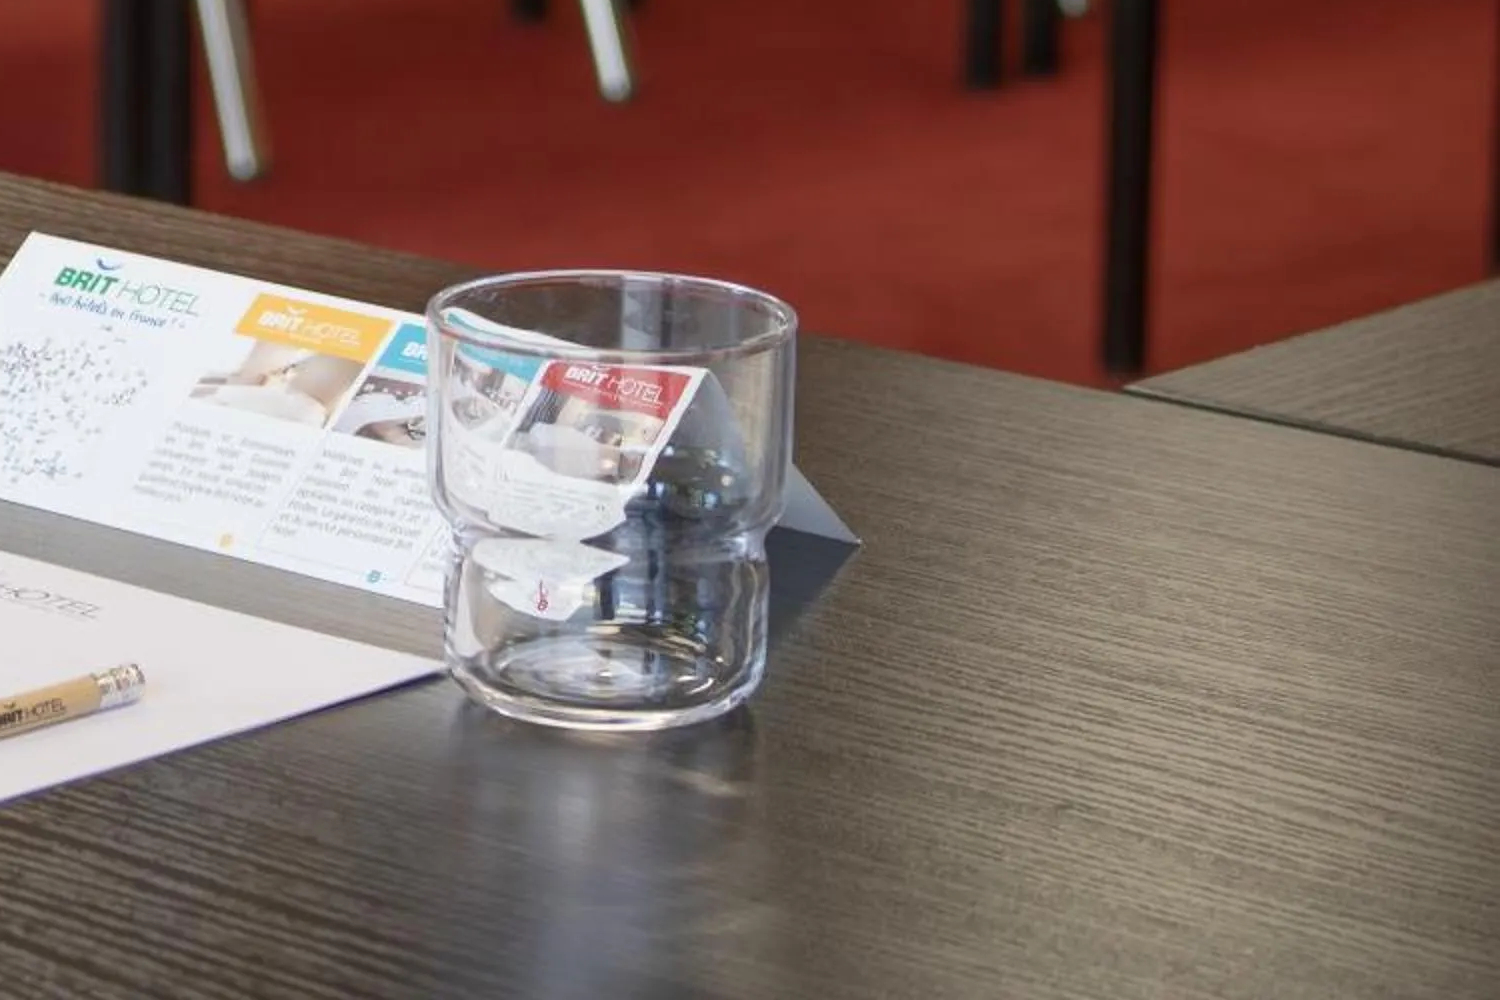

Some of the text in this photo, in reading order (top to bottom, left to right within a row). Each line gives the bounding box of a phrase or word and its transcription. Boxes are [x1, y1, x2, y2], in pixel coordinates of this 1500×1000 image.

[54, 266, 200, 317] BRIT HOTEL
[257, 310, 362, 347] BRIT HOTEL
[563, 366, 663, 403] BRIT HOTEL
